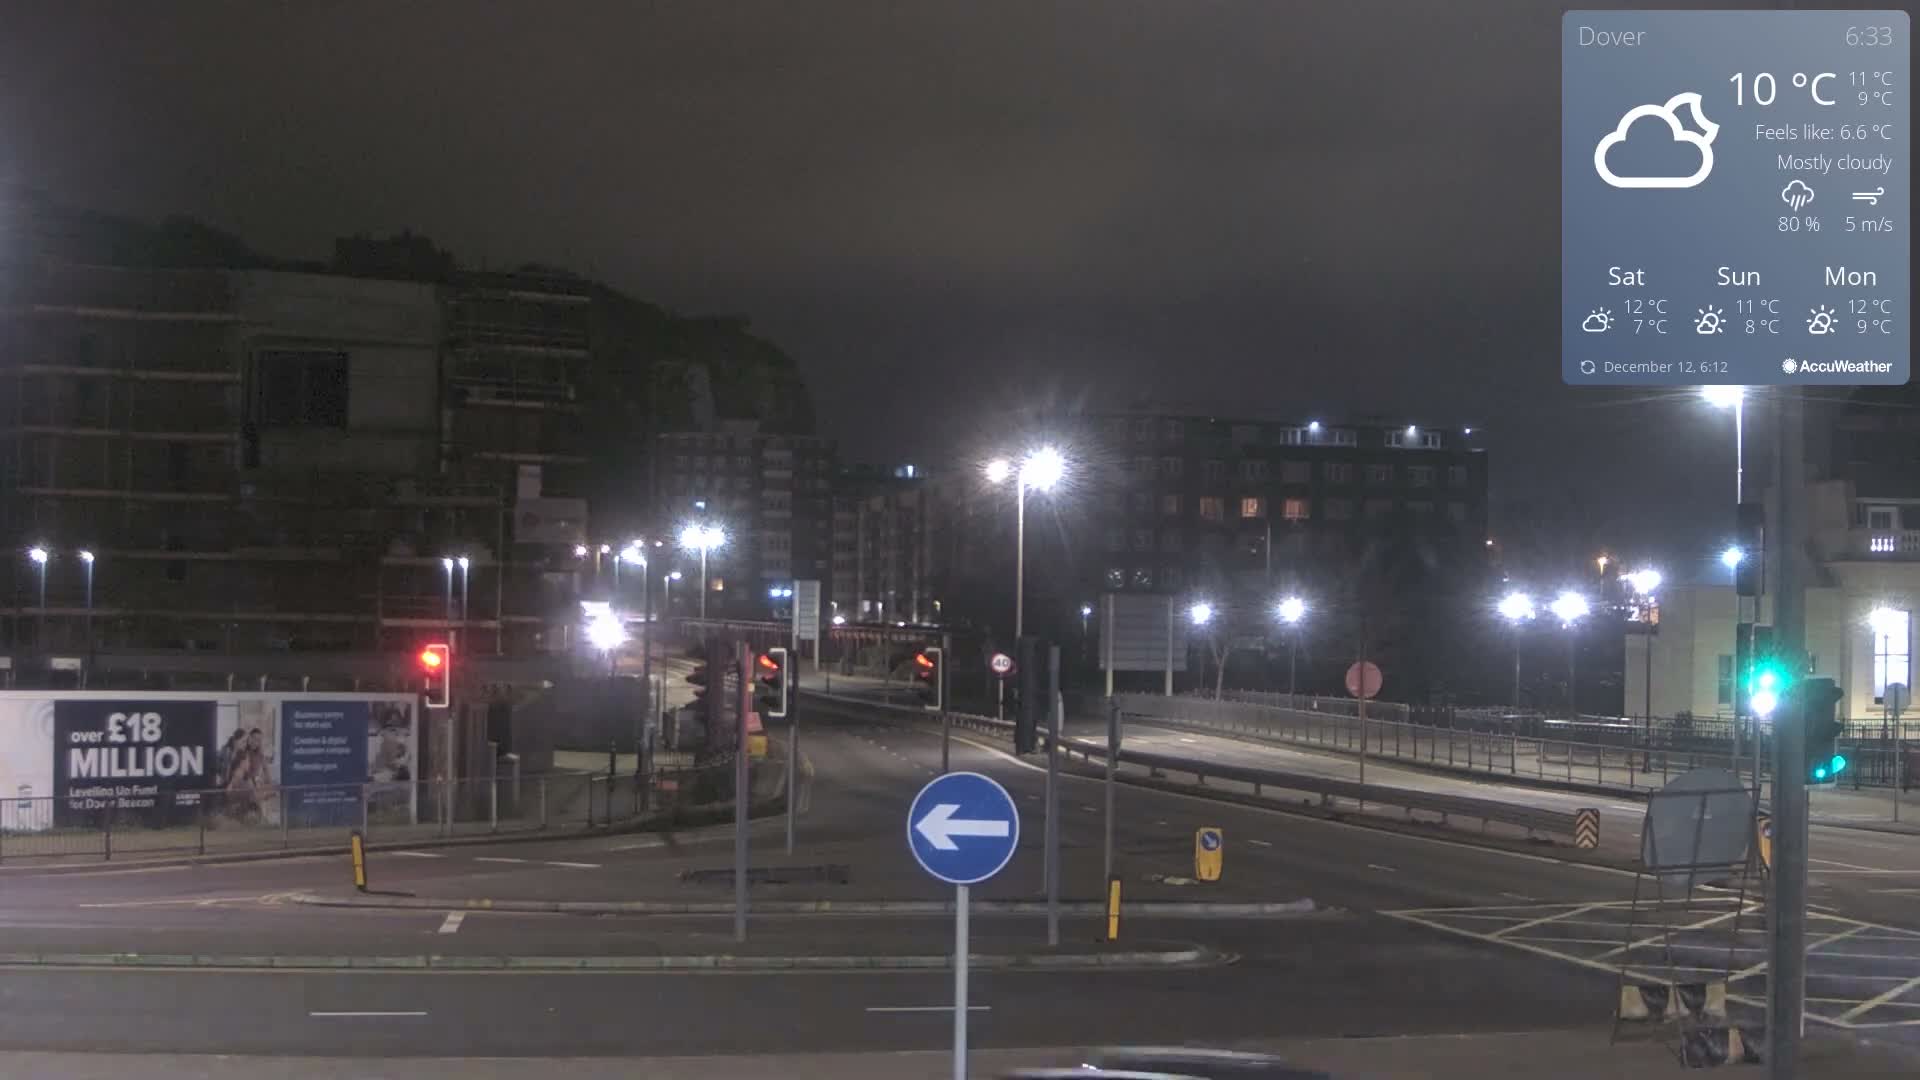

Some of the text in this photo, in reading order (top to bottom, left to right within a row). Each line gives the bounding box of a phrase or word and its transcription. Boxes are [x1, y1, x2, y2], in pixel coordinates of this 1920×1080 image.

[994, 658, 1009, 668] 40
[71, 712, 162, 743] over £18
[71, 746, 204, 778] MILLION
